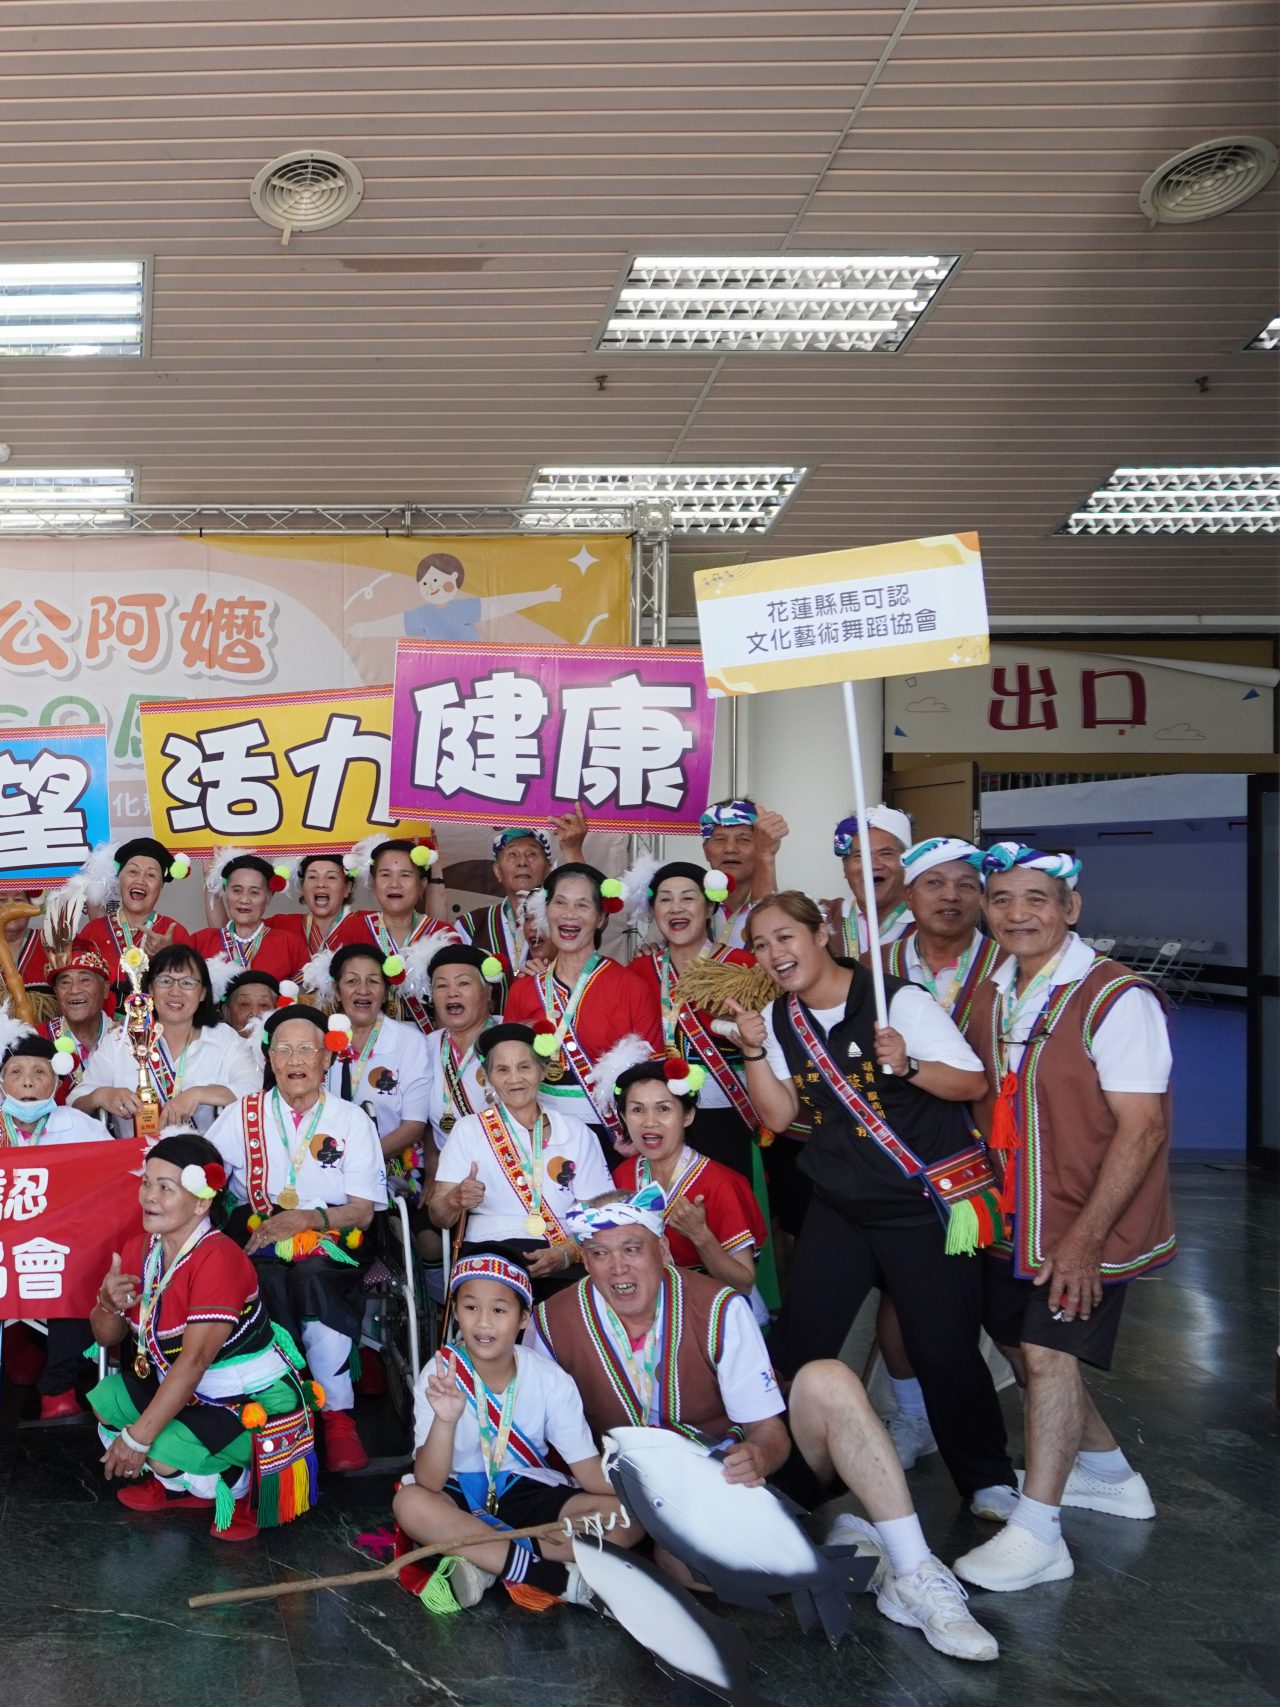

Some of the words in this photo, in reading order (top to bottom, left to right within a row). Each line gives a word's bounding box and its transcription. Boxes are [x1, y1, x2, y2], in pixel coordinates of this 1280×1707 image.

[746, 608, 937, 654] 文化藝術舞蹈協會
[767, 583, 911, 623] 花蓮縣馬可認
[987, 663, 1148, 731] 出口
[410, 668, 695, 809] 健康
[160, 713, 400, 836] 活力
